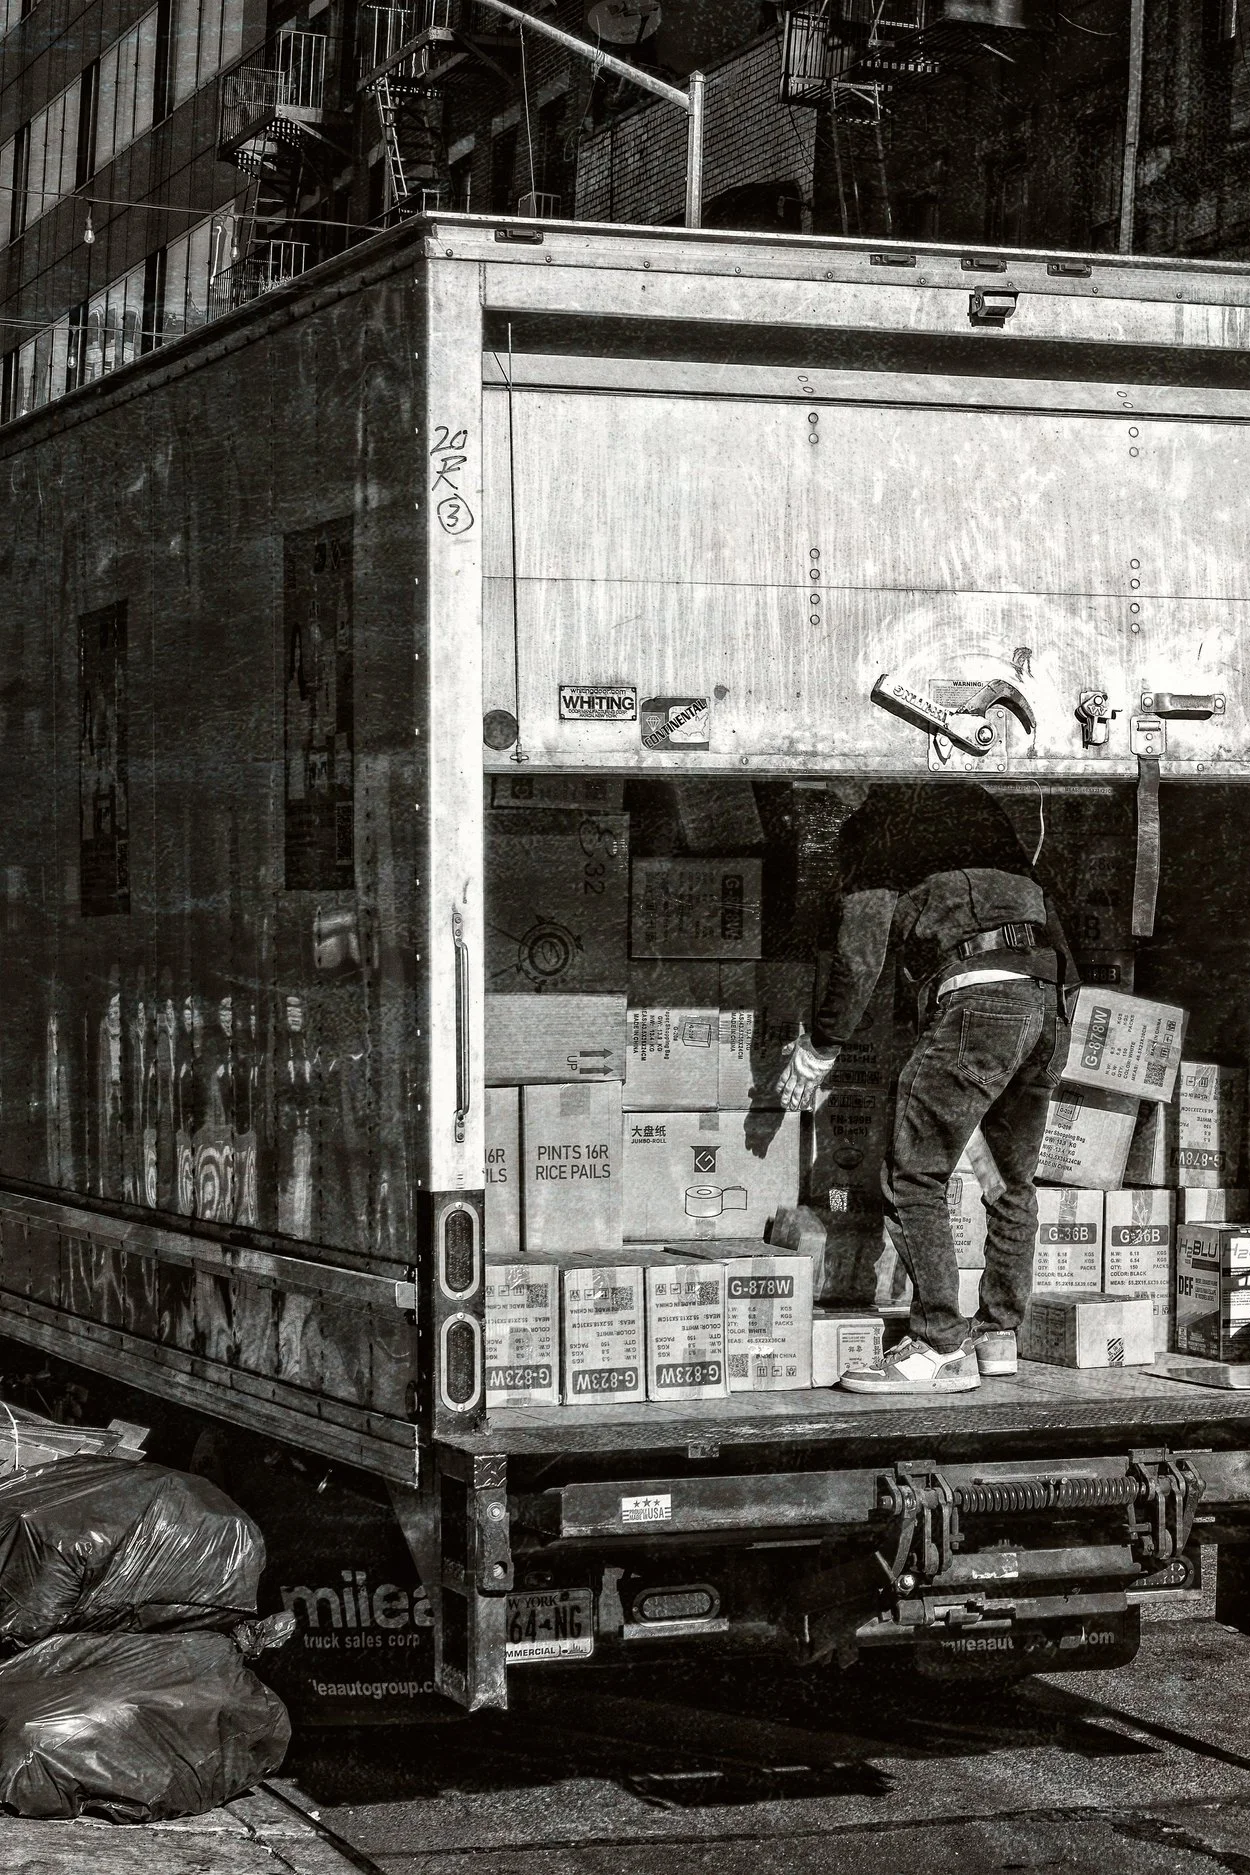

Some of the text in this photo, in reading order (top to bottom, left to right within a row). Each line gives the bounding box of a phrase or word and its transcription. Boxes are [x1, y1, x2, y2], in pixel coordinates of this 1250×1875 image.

[562, 695, 635, 710] WHITING
[643, 698, 708, 749] CONTINENTAL
[1085, 1010, 1108, 1066] G-878W
[566, 1055, 578, 1071] UP
[631, 1125, 667, 1138] 大盘纸
[537, 1144, 609, 1160] PINTS 16R
[536, 1164, 611, 1180] RICE PAILS
[1049, 1227, 1089, 1240] G-36B
[1120, 1229, 1160, 1243] G-36B
[731, 1280, 791, 1296] G-878W
[1178, 1275, 1194, 1296] DEF
[489, 1368, 550, 1387] G-823W
[576, 1371, 636, 1390] G-823W
[661, 1364, 719, 1384] G-823W
[648, 1507, 664, 1519] USA
[525, 1594, 558, 1609] YORK
[303, 1632, 421, 1649] truck sales corp
[506, 1646, 556, 1658] MMERCIAL
